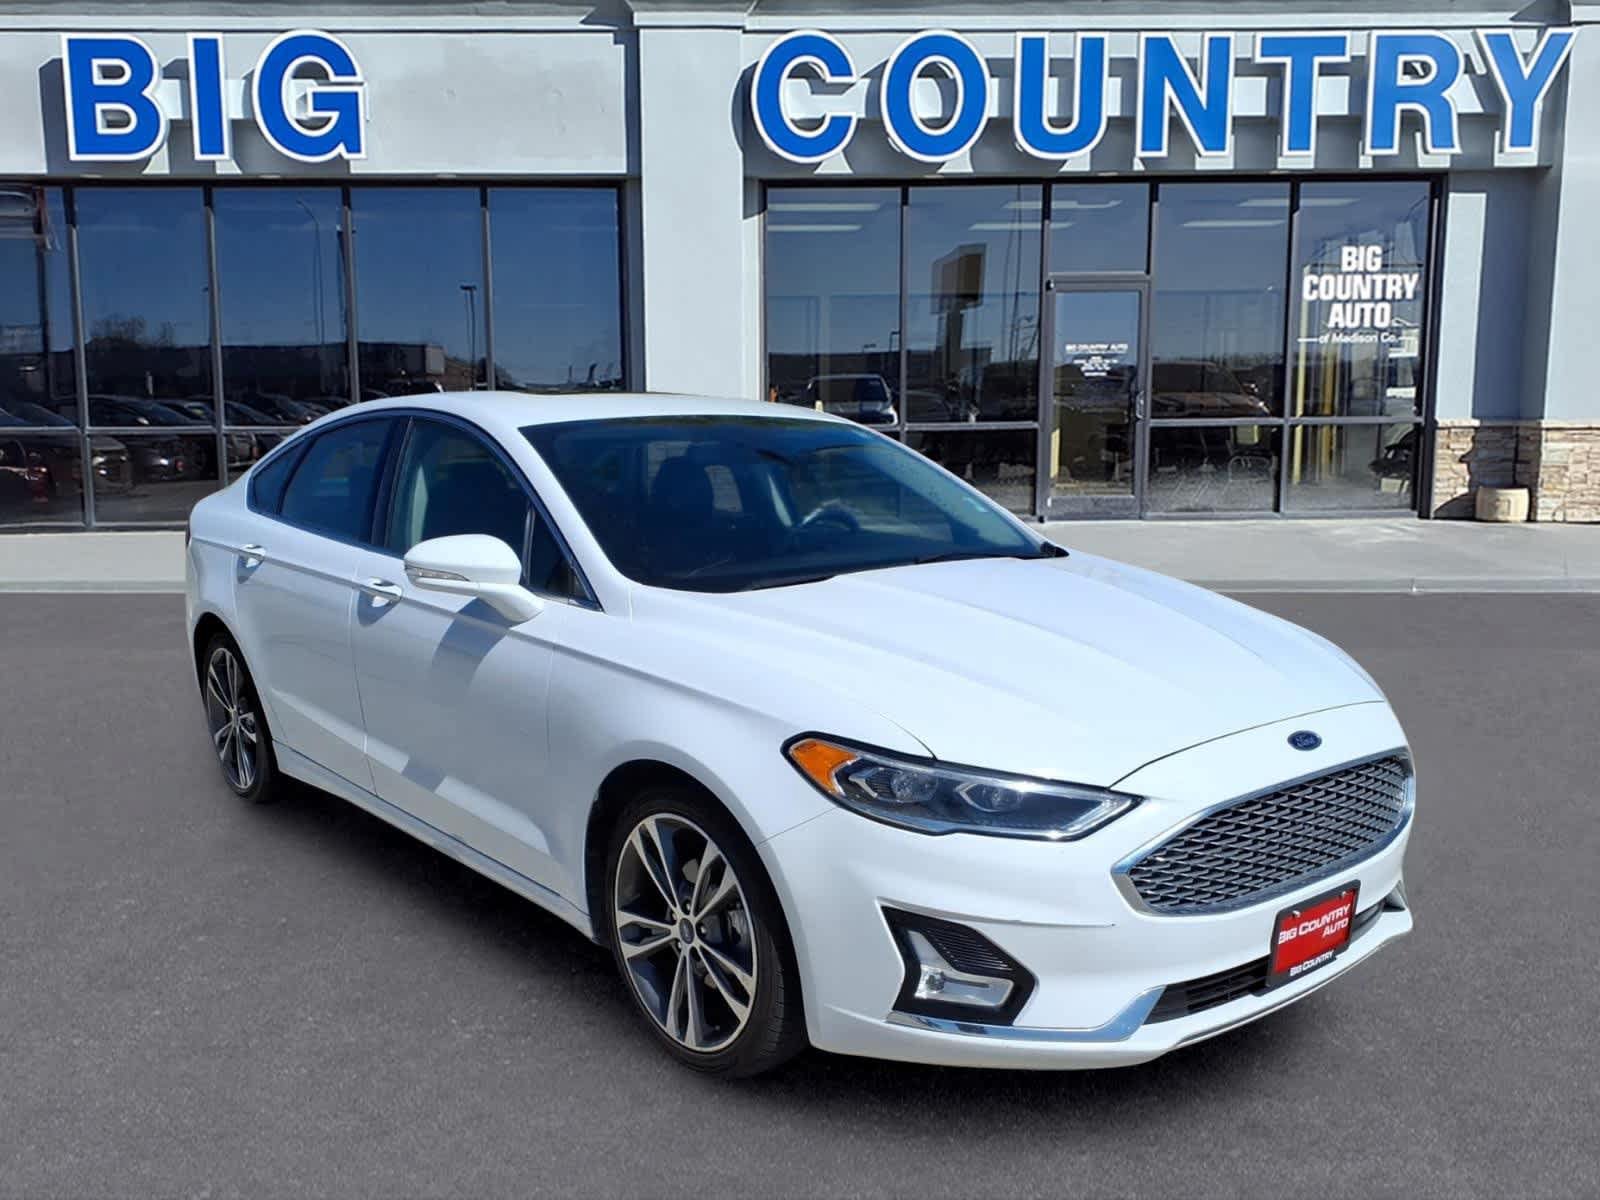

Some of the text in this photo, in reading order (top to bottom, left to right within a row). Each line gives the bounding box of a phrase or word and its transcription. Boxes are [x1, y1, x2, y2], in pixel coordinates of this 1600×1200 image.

[61, 27, 1575, 164] BIG COUNTRY
[1341, 245, 1383, 272] BIG
[1302, 273, 1419, 301] COUNTRY
[1327, 302, 1392, 329] AUTO
[1278, 903, 1351, 944] BIG COUNTRY
[1322, 917, 1349, 938] AUTO
[1302, 950, 1335, 971] COUNTRY
